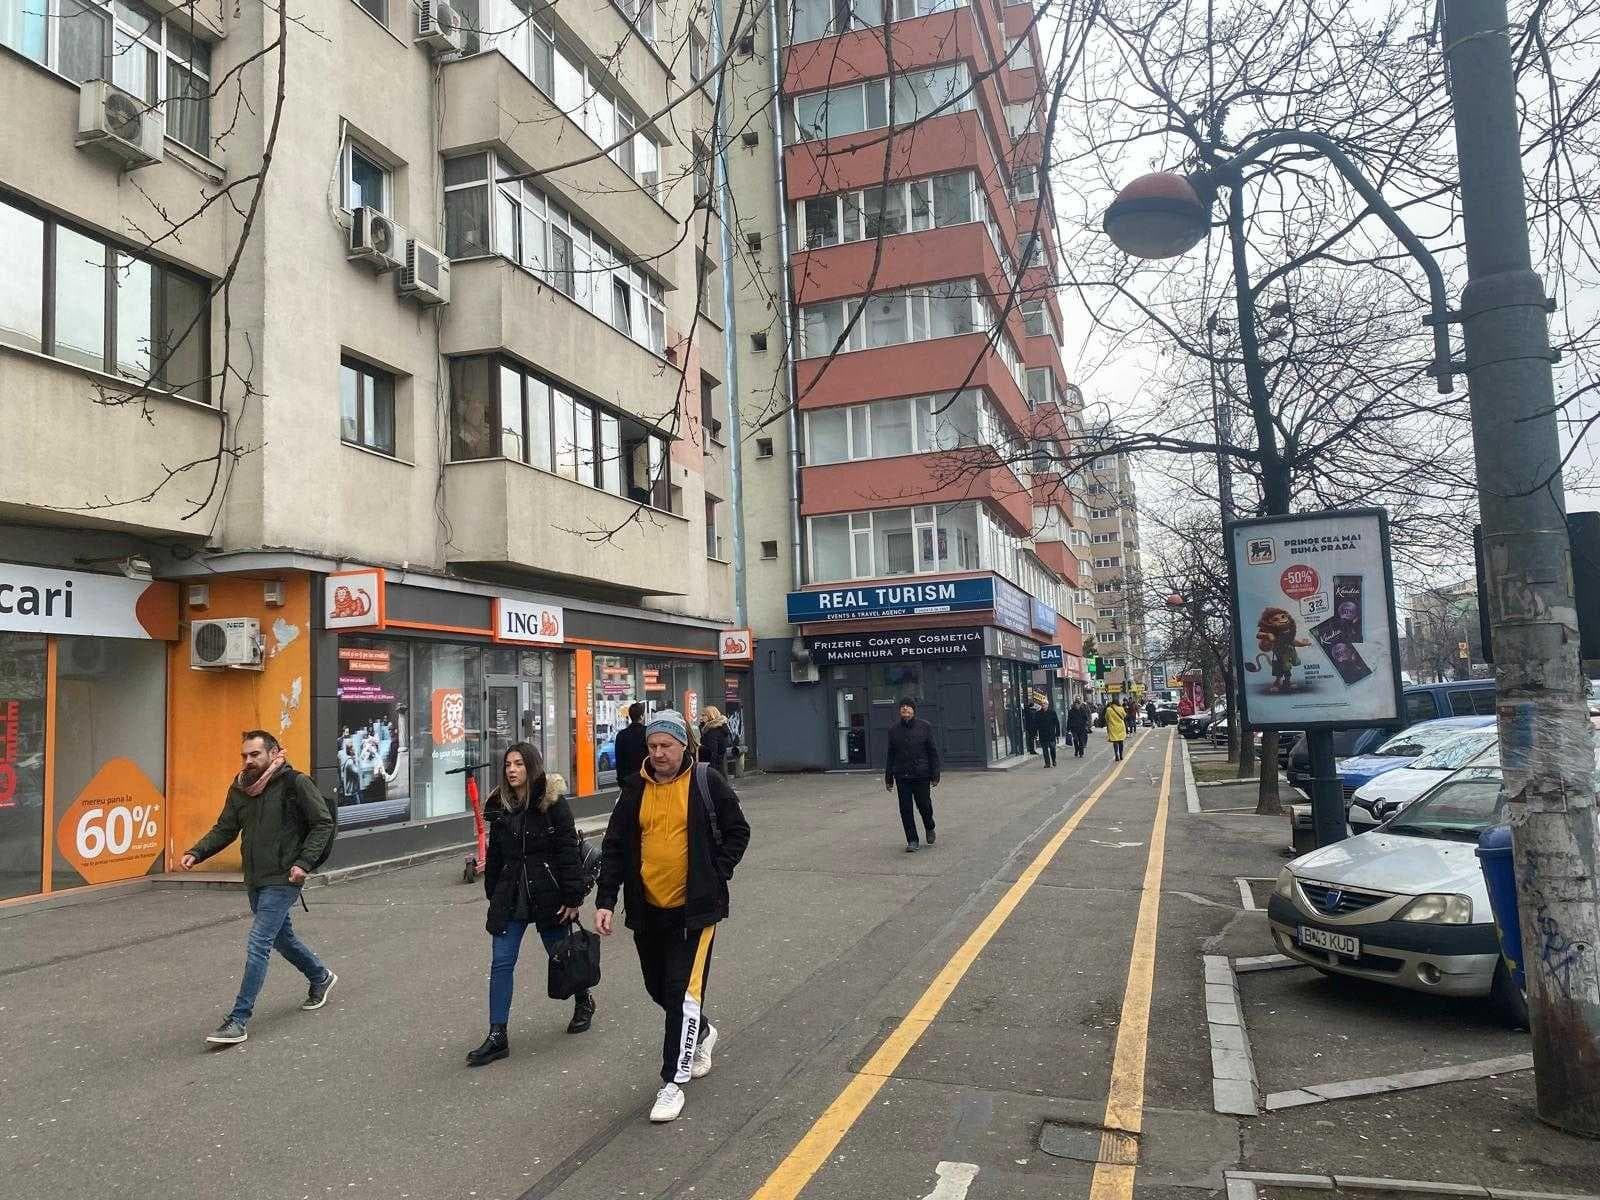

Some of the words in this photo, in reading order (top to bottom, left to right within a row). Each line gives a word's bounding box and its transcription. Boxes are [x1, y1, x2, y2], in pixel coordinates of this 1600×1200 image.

[1341, 533, 1361, 542] MAI
[0, 580, 73, 618] cari
[819, 592, 869, 609] REAL
[875, 584, 956, 605] TURISM
[507, 611, 538, 635] ING
[827, 612, 850, 620] EVENTS
[858, 610, 881, 618] TRAVEL
[882, 608, 907, 616] AGENCY
[1329, 934, 1355, 953] KUD
